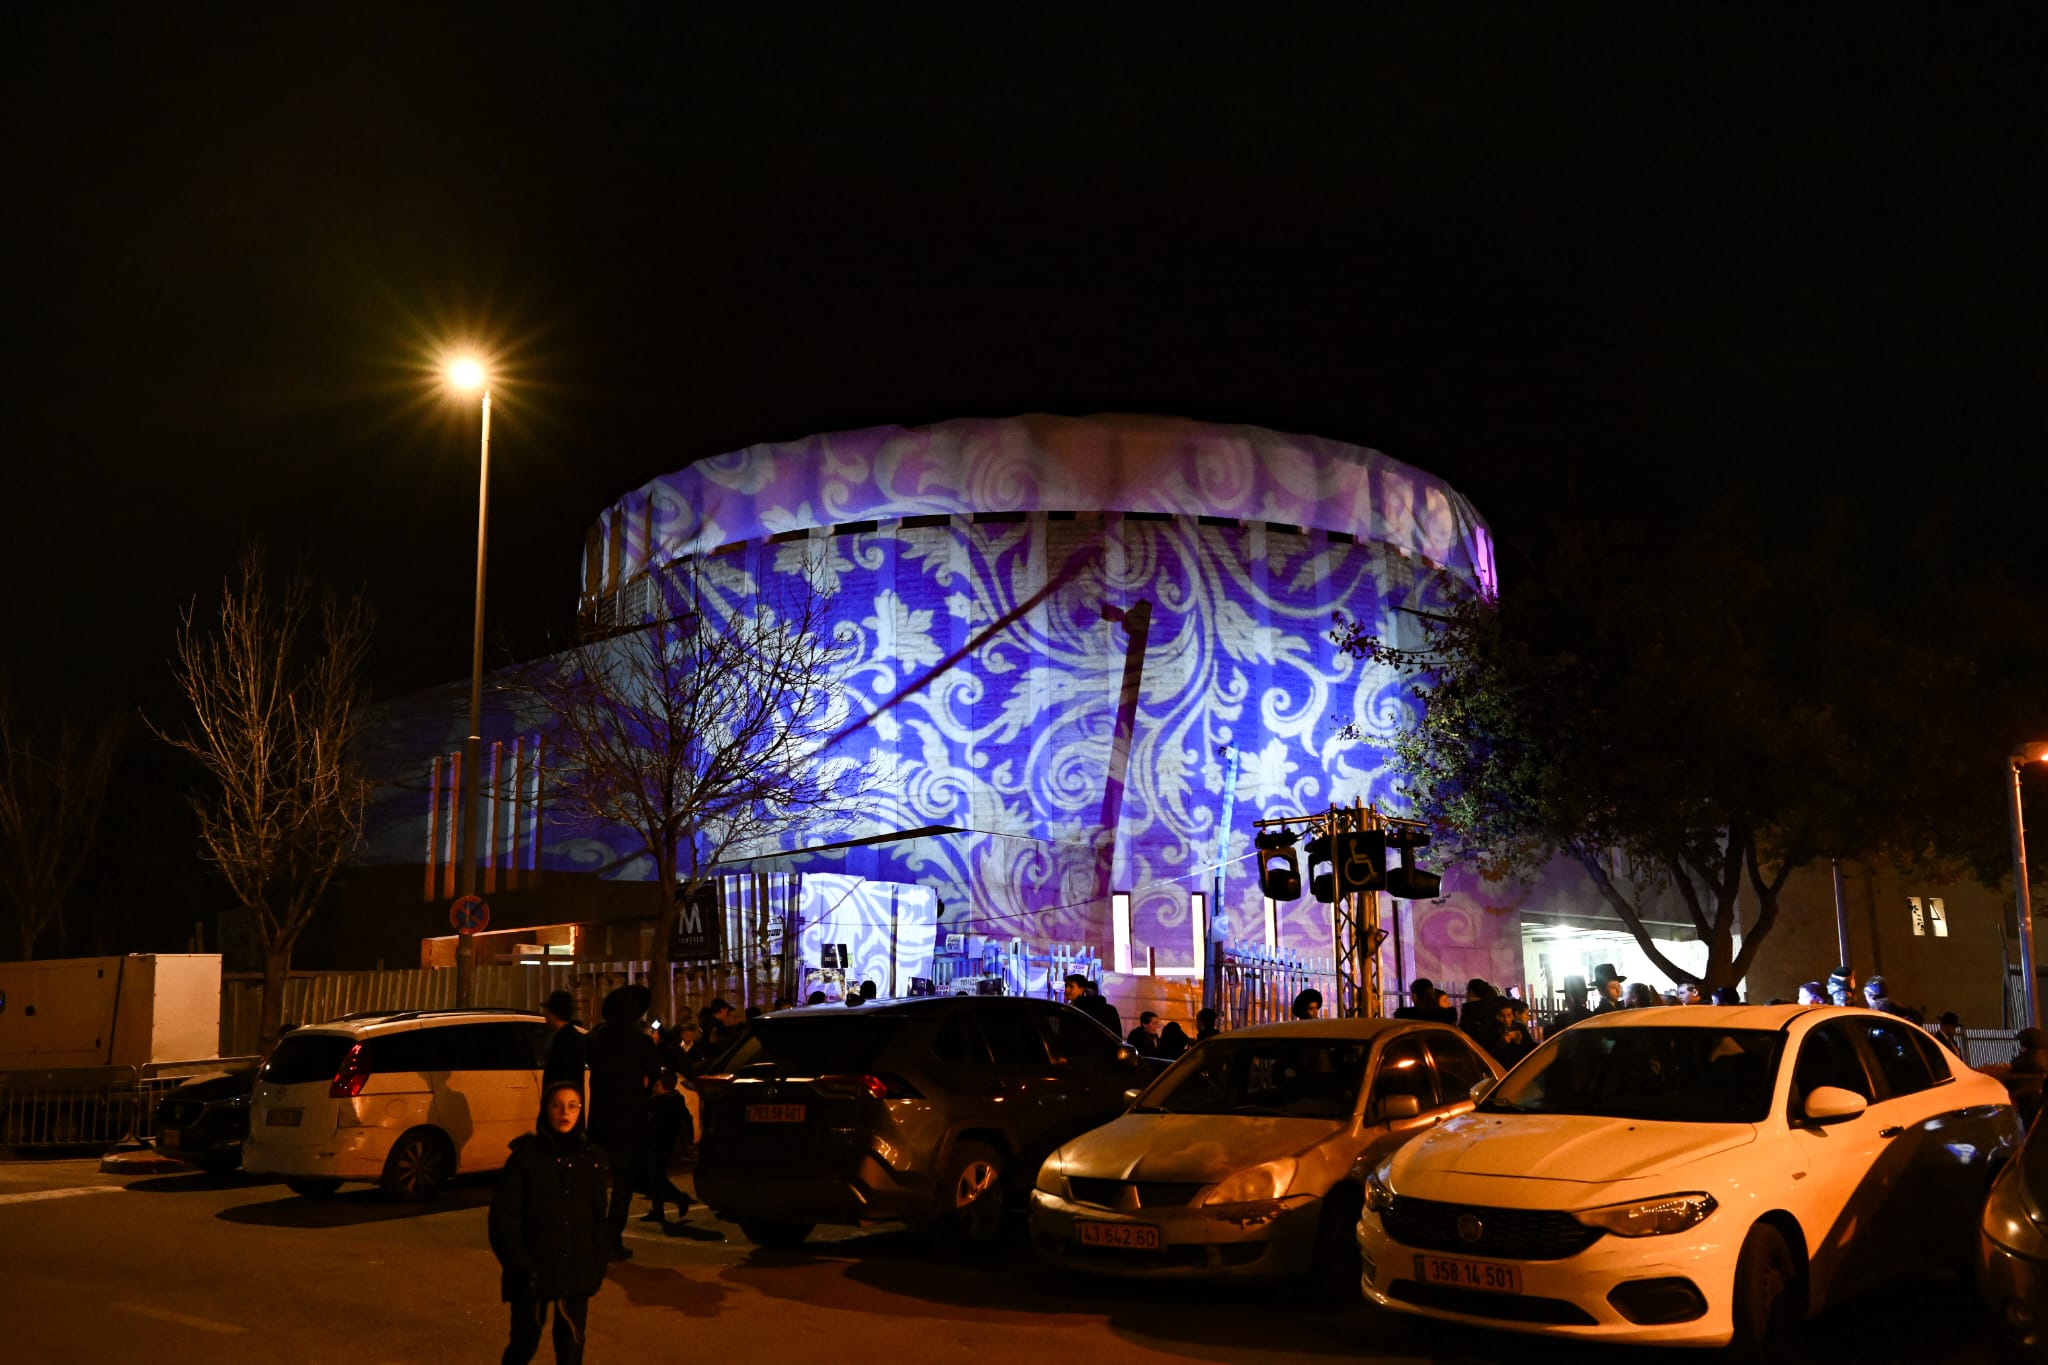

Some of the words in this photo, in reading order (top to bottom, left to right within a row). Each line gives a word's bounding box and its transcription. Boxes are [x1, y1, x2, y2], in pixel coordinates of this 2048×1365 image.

[678, 902, 703, 935] M
[1084, 1225, 1100, 1242] 43
[1105, 1227, 1131, 1245] 642
[1136, 1229, 1155, 1246] 60
[1432, 1260, 1459, 1281] 358
[1464, 1263, 1481, 1286] 14
[1485, 1266, 1514, 1289] 501
